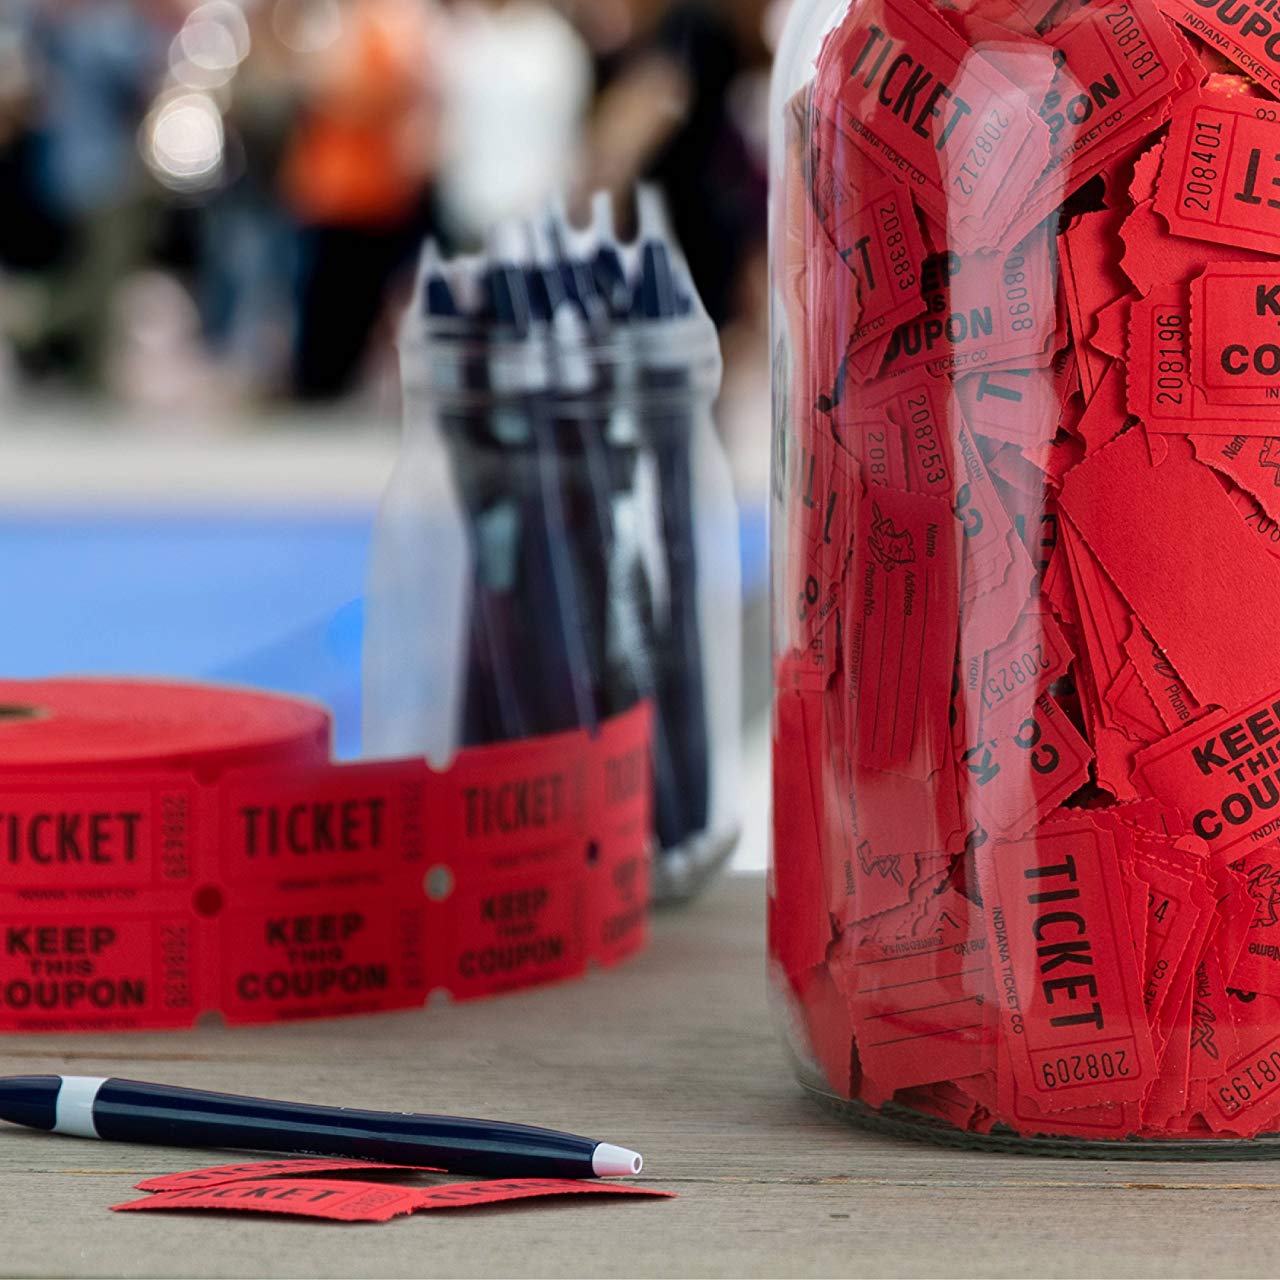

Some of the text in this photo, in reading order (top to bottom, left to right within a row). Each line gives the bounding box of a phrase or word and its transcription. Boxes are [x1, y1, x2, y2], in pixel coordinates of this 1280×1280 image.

[1105, 4, 1161, 80] 208181
[1182, 11, 1231, 51] INDIANA
[1231, 47, 1274, 83] TICKET
[850, 24, 971, 151] TICKET
[881, 143, 915, 177] TICKET
[953, 108, 1009, 198] 208212
[1066, 123, 1102, 158] TICKET
[1184, 120, 1223, 212] 208401
[880, 201, 915, 291] 208383
[1156, 314, 1185, 405] 208196
[908, 394, 946, 484] 208253
[926, 523, 938, 558] Name
[985, 644, 1049, 710] 208251
[1163, 683, 1191, 721] Phone
[240, 799, 384, 857] TICKET
[465, 775, 562, 838] TICKET
[5, 926, 117, 956] KEEP
[267, 912, 364, 946] KEEP
[992, 906, 1012, 968] INDIANA
[1024, 854, 1105, 1030] TICKET
[4, 979, 146, 1010] OUPON
[29, 959, 94, 976] THIS
[238, 965, 388, 1002] COUPON
[1001, 967, 1020, 1011] TICKET
[1043, 1050, 1131, 1089] 208209
